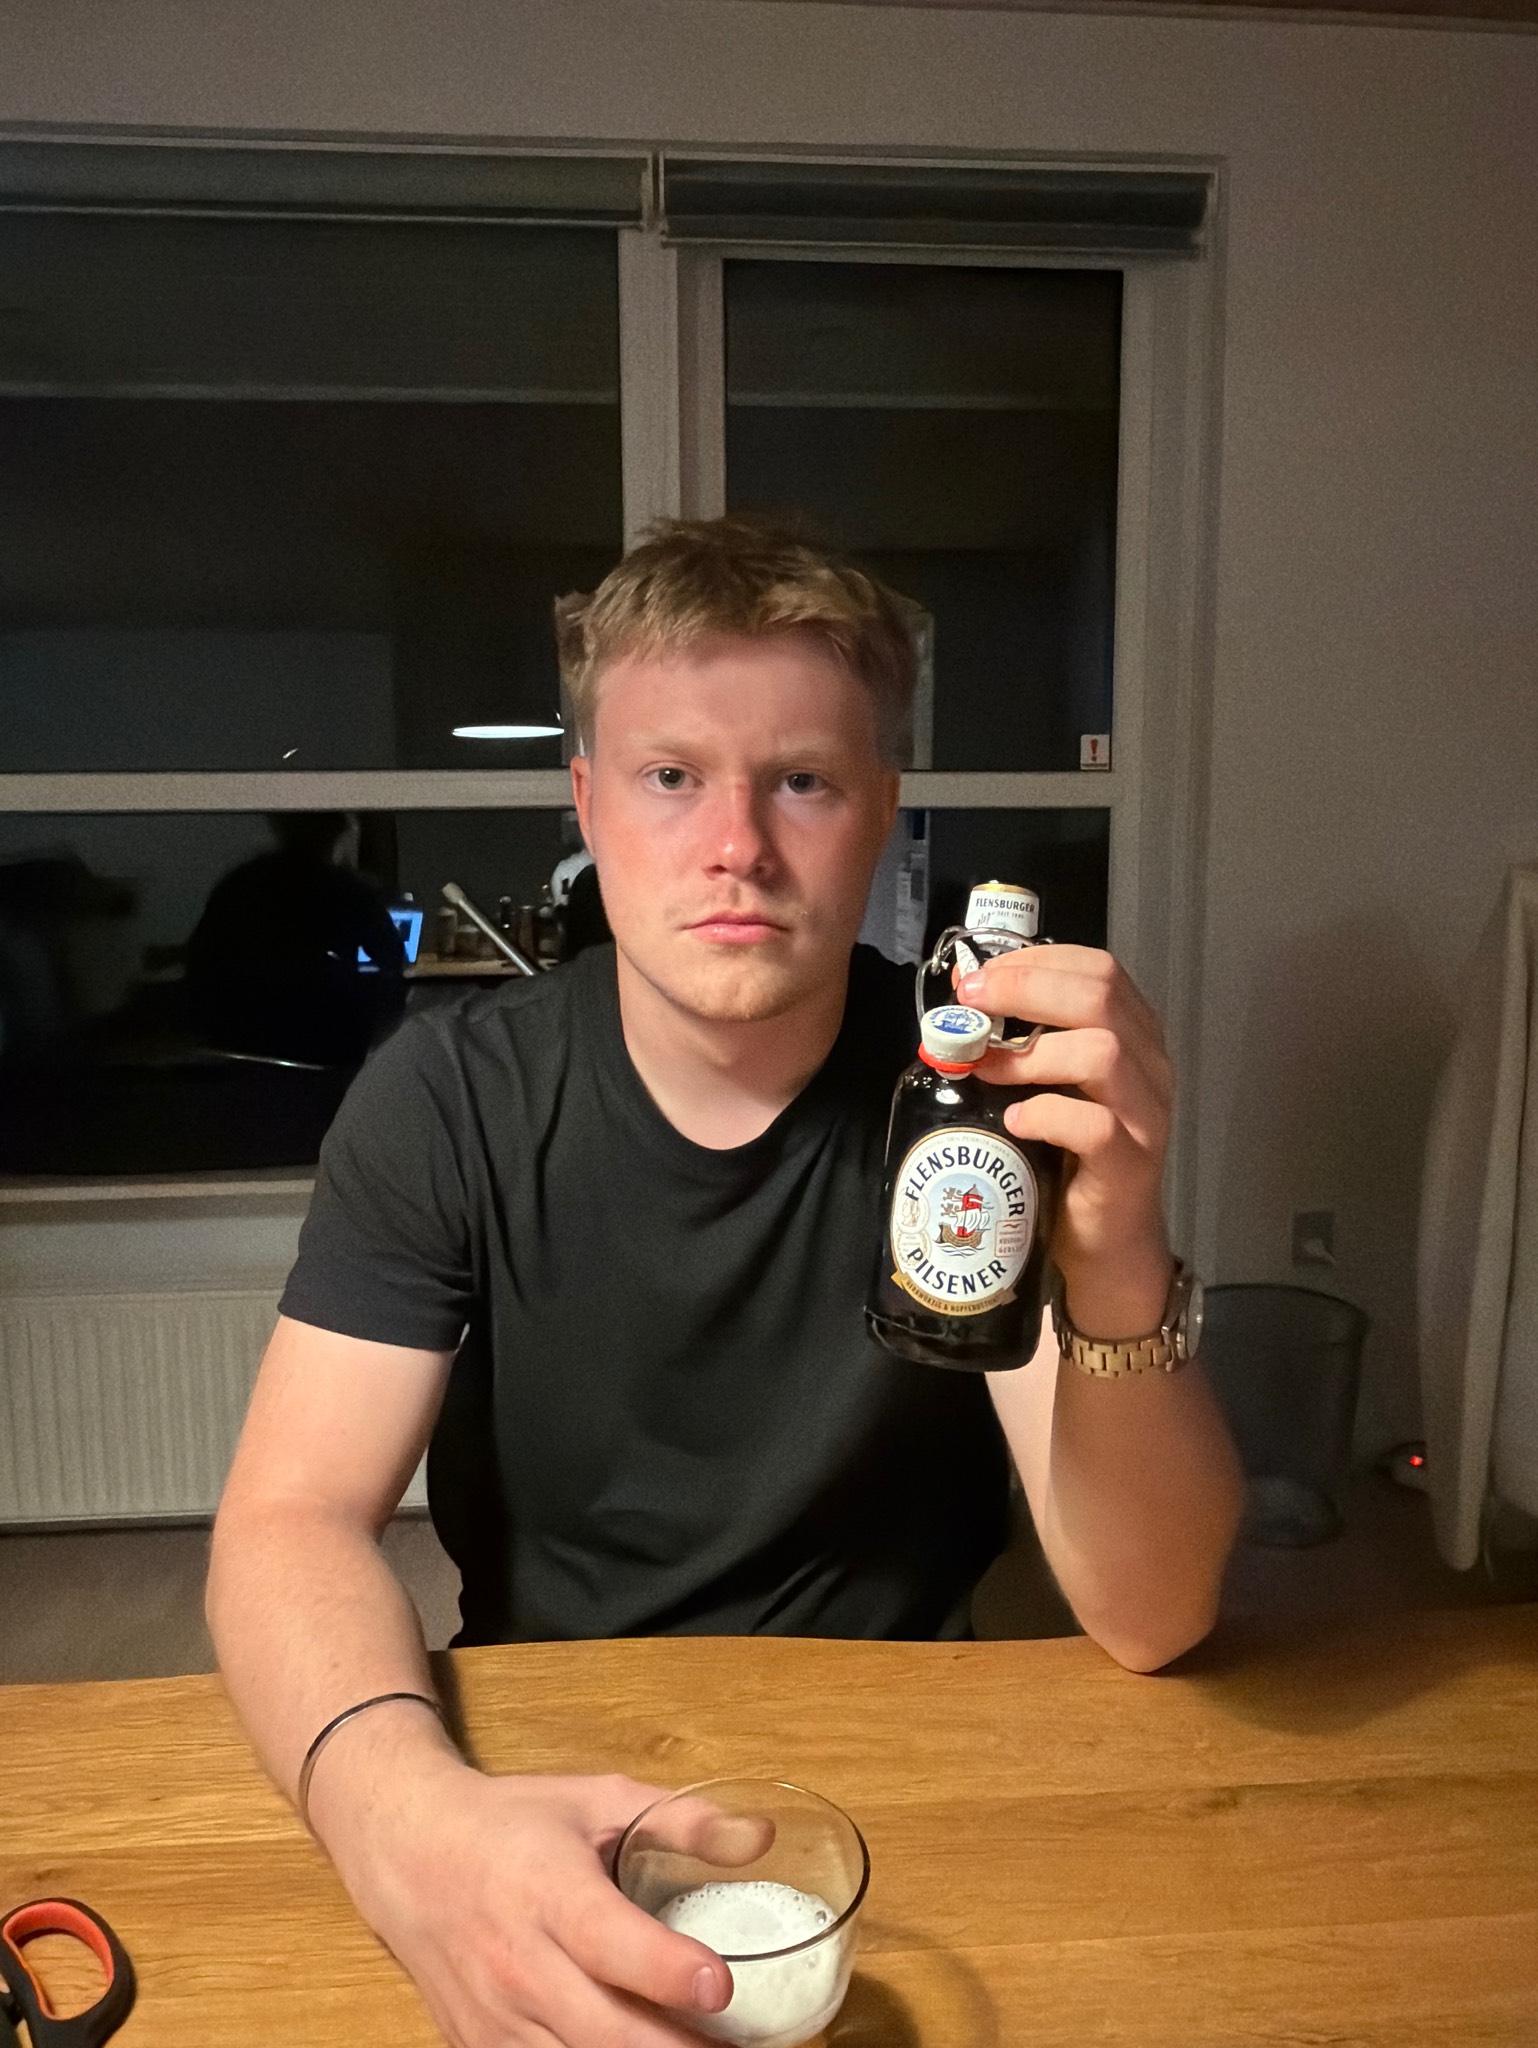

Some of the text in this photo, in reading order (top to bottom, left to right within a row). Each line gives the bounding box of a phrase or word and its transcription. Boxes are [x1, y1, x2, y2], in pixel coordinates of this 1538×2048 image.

[976, 898, 1035, 913] FLENSBURGER
[905, 1146, 1026, 1218] FLENSBURGER
[907, 1247, 1008, 1296] PILSENER
